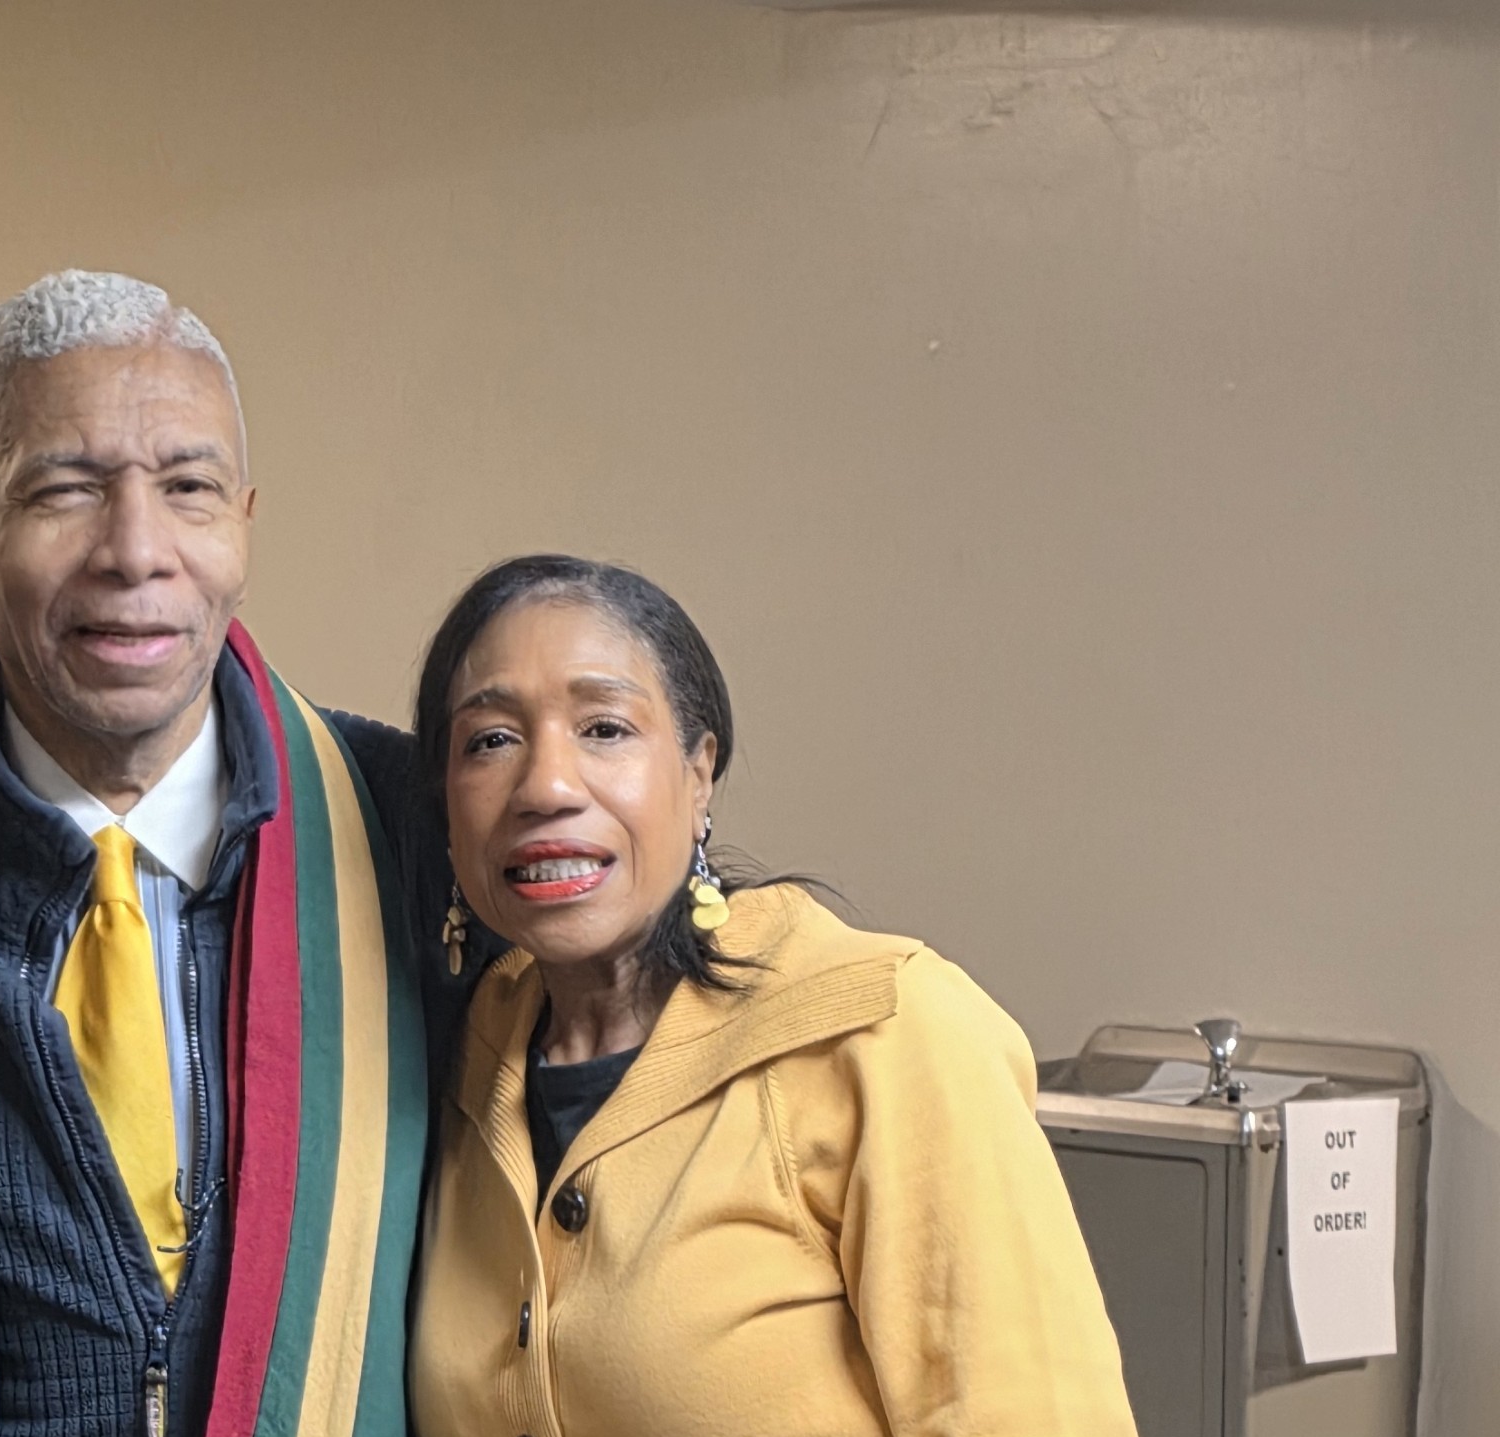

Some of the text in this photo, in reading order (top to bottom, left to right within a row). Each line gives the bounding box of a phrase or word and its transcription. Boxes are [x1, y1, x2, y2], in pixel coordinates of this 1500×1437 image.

[1325, 1130, 1357, 1149] OUT
[1330, 1171, 1351, 1190] OF
[1314, 1211, 1367, 1232] ORDER!
